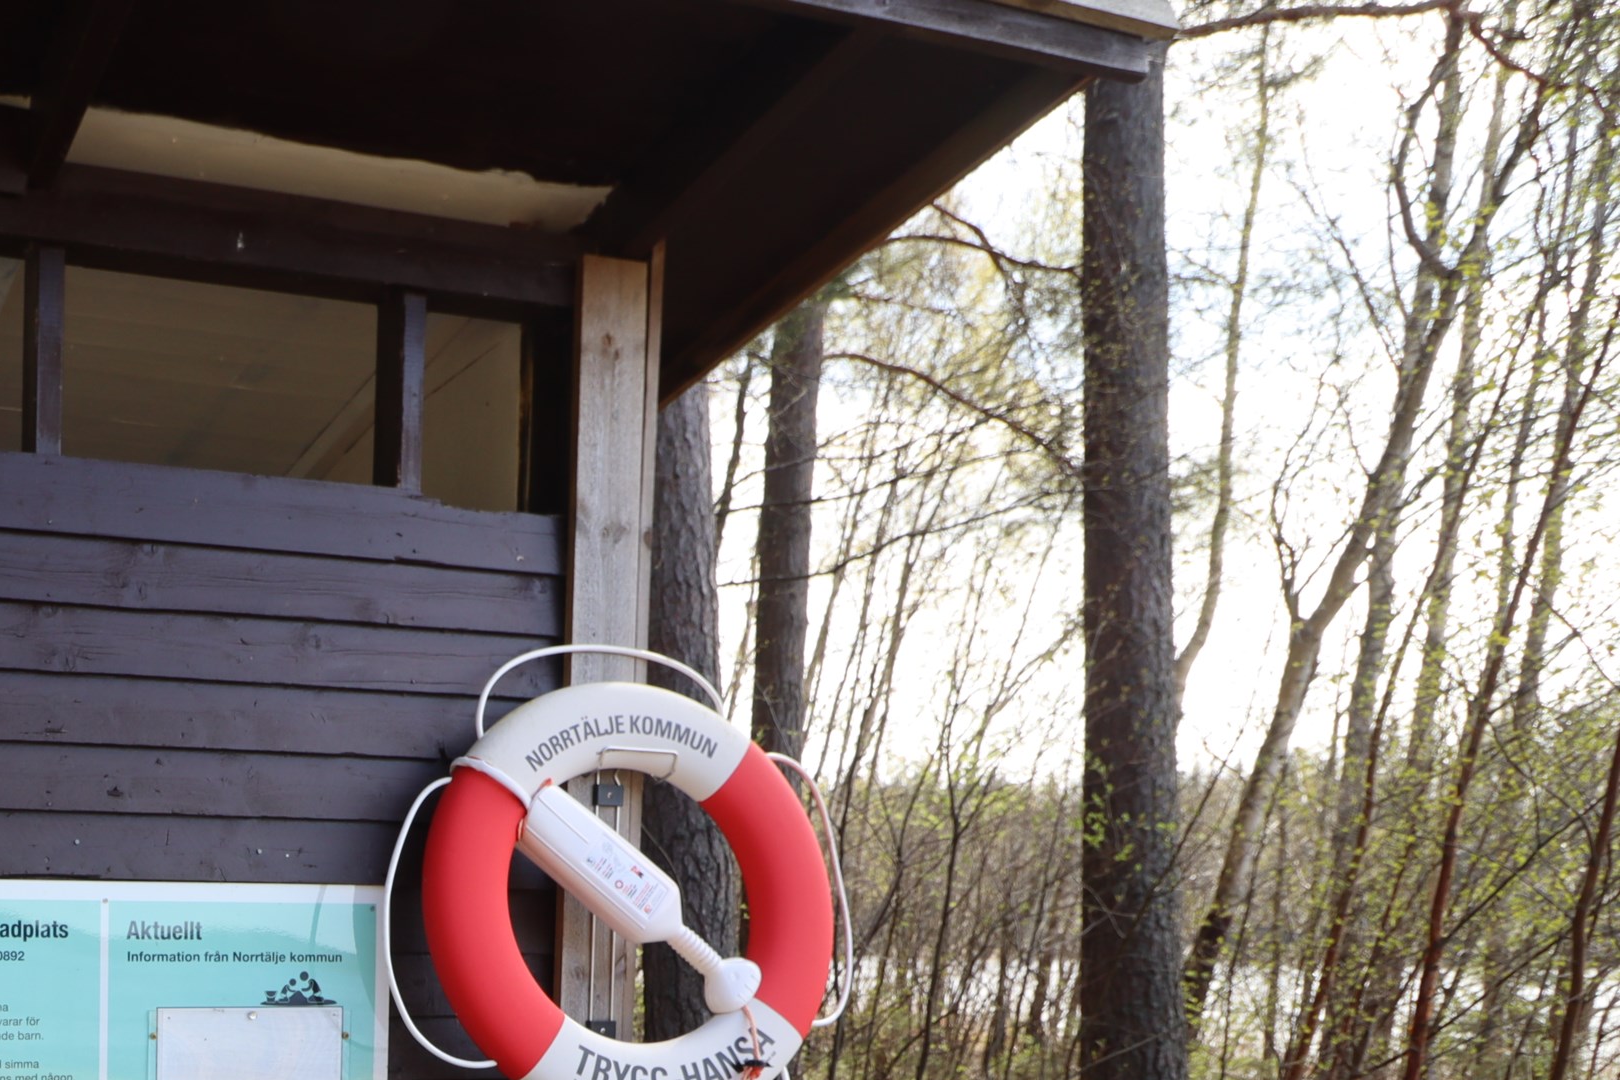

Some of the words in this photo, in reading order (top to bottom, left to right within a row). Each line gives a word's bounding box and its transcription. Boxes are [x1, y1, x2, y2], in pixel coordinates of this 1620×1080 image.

[524, 715, 626, 772] NORRTÄLJE
[629, 717, 719, 758] KOMMUN
[127, 921, 202, 940] Aktuellt
[127, 951, 200, 962] Information
[204, 951, 228, 962] från
[233, 952, 286, 964] Norrtälje
[290, 952, 342, 962] kommun
[26, 1017, 39, 1026] för
[17, 1031, 44, 1041] barn.
[5, 1060, 39, 1069] simma
